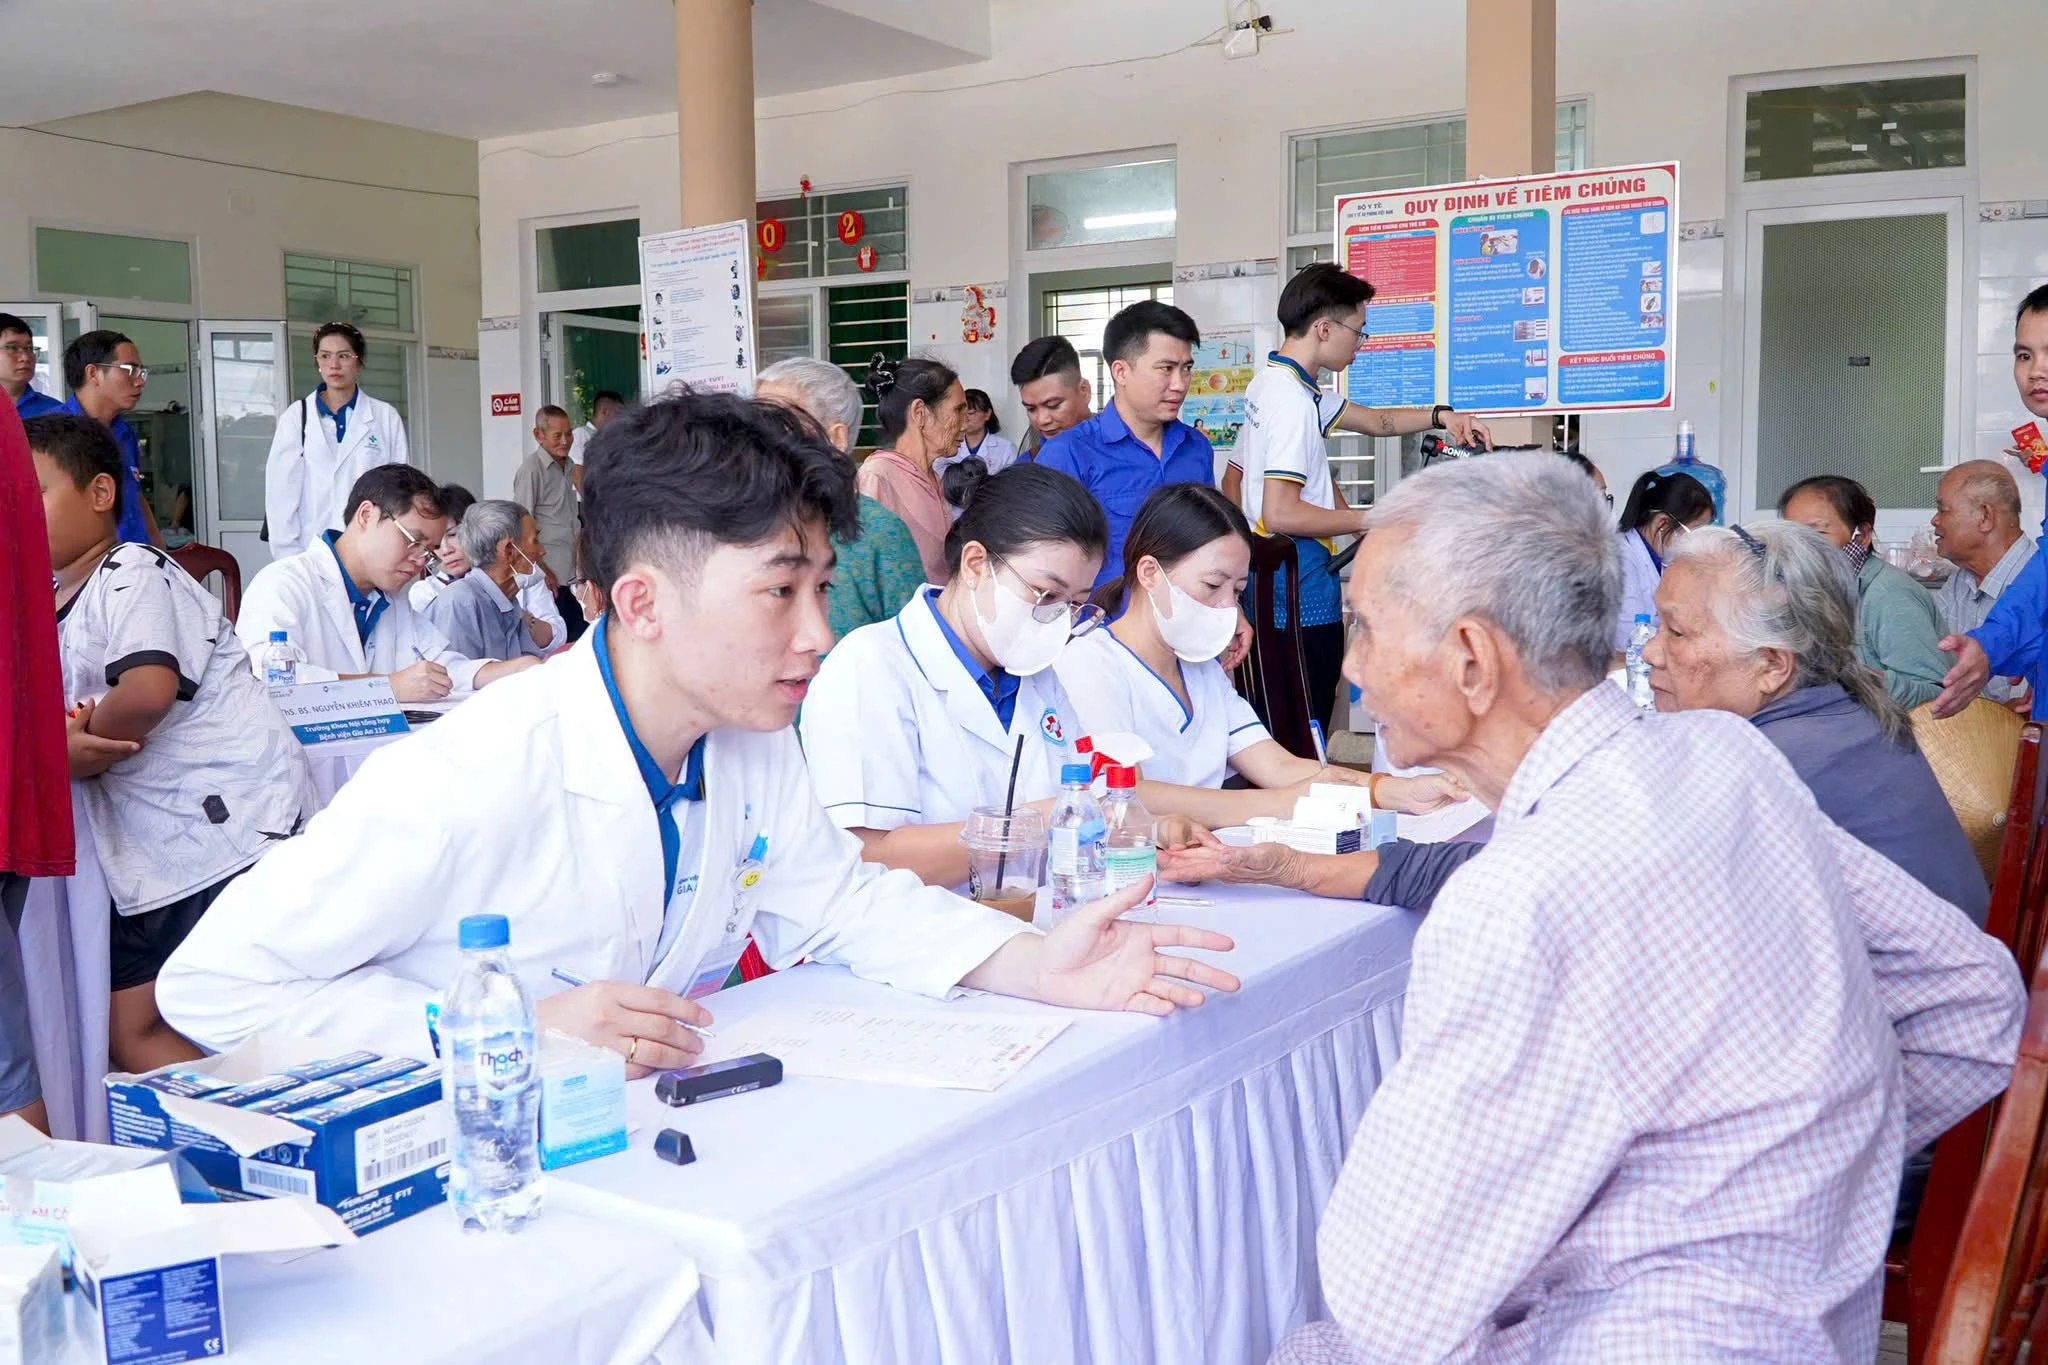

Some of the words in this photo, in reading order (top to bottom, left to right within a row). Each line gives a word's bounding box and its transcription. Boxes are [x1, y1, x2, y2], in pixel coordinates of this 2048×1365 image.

[1404, 199, 1439, 215] QUY
[1444, 194, 1489, 213] ĐỊNH
[1495, 186, 1518, 206] VỀ
[1524, 184, 1571, 204] TIÊM
[1578, 176, 1646, 198] CHỦNG
[842, 213, 856, 238] 2
[763, 222, 776, 248] 0
[1617, 353, 1632, 361] TIÊM
[1633, 352, 1656, 361] CHỦNG
[1442, 445, 1470, 458] RONIN
[298, 706, 312, 716] BS.
[312, 701, 346, 713] NGUYỄN
[331, 722, 348, 730] Khoa
[319, 731, 337, 742] Bệnh
[338, 730, 352, 740] viện
[352, 728, 364, 737] Gia
[375, 726, 387, 735] 115
[676, 883, 693, 895] GIA
[394, 1186, 414, 1201] FIT
